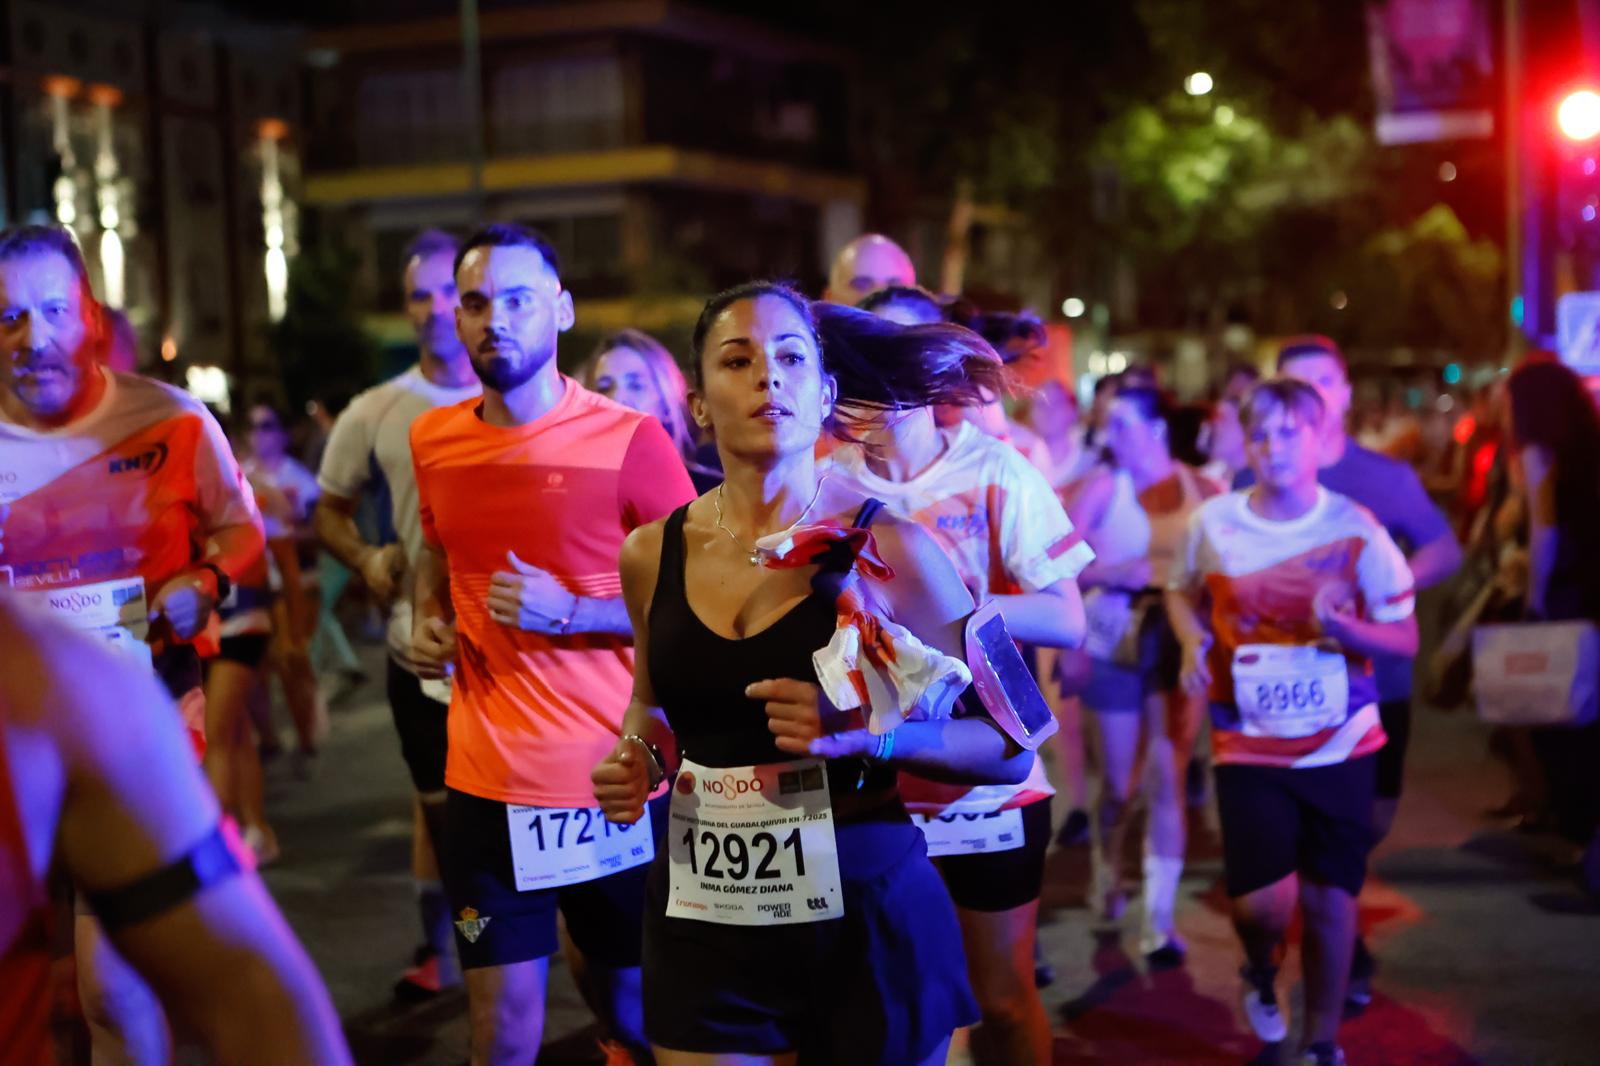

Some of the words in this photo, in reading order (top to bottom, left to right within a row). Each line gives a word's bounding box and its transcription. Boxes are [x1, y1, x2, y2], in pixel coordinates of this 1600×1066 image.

[1256, 680, 1325, 711] 8966
[716, 819, 729, 829] DEL
[730, 817, 787, 829] GUADALQUIVIR
[807, 812, 828, 822] 2025
[682, 827, 806, 880] 12921
[700, 882, 721, 893] INMA
[723, 883, 757, 895] GÓMEZ
[760, 883, 794, 893] DIANA
[757, 902, 791, 912] POWER
